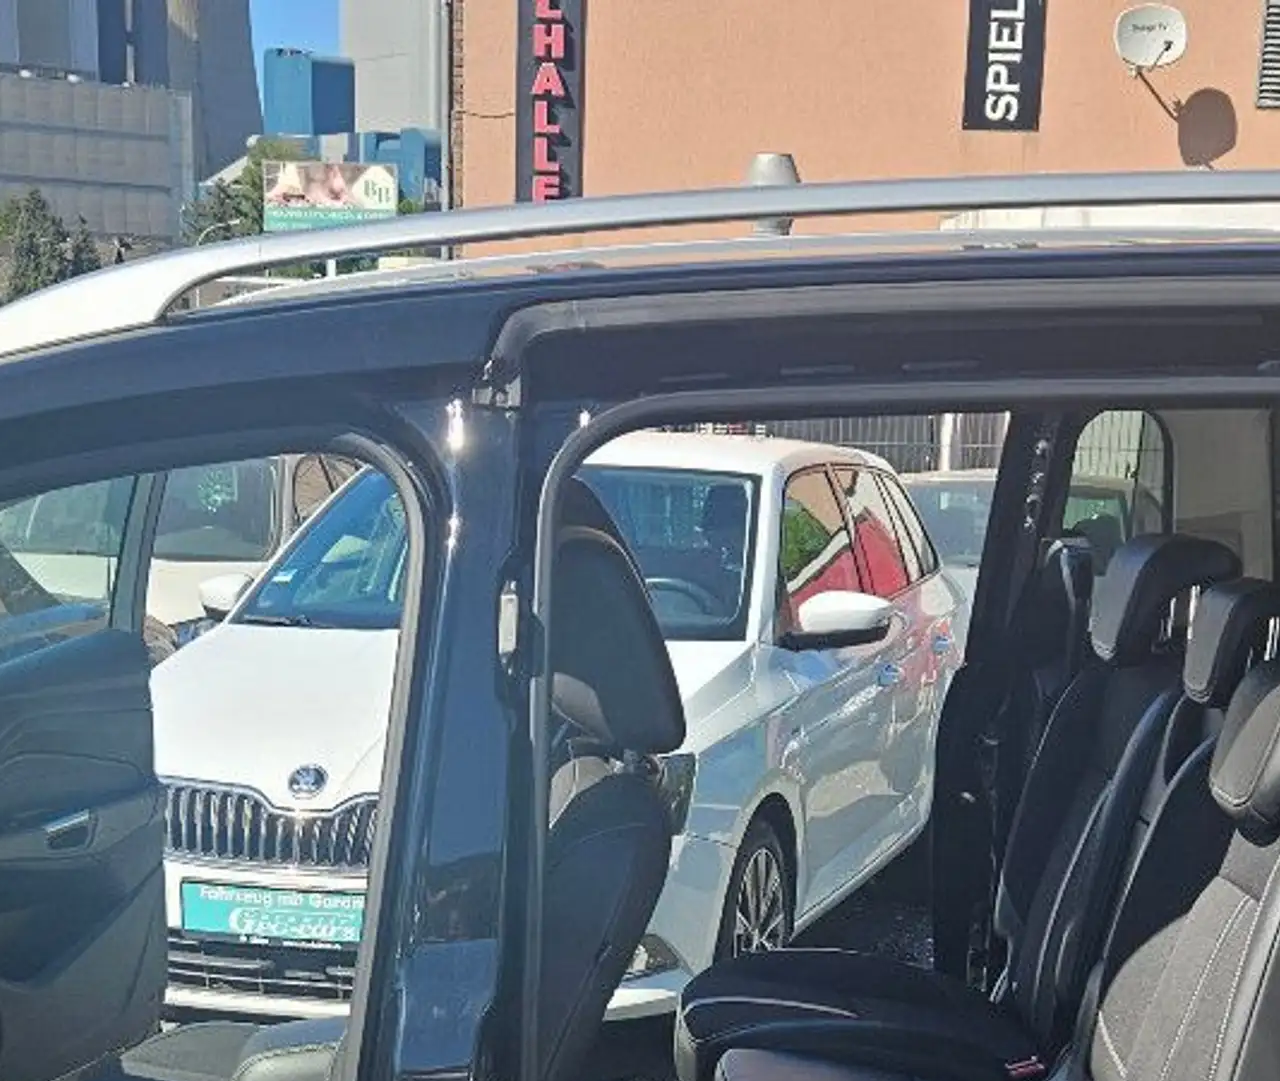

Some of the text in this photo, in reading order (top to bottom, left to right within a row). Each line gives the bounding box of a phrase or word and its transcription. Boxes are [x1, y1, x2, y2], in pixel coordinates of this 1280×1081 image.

[984, 0, 1025, 121] SPIEL
[199, 885, 273, 908] Fahrzeug
[277, 893, 304, 907] mit
